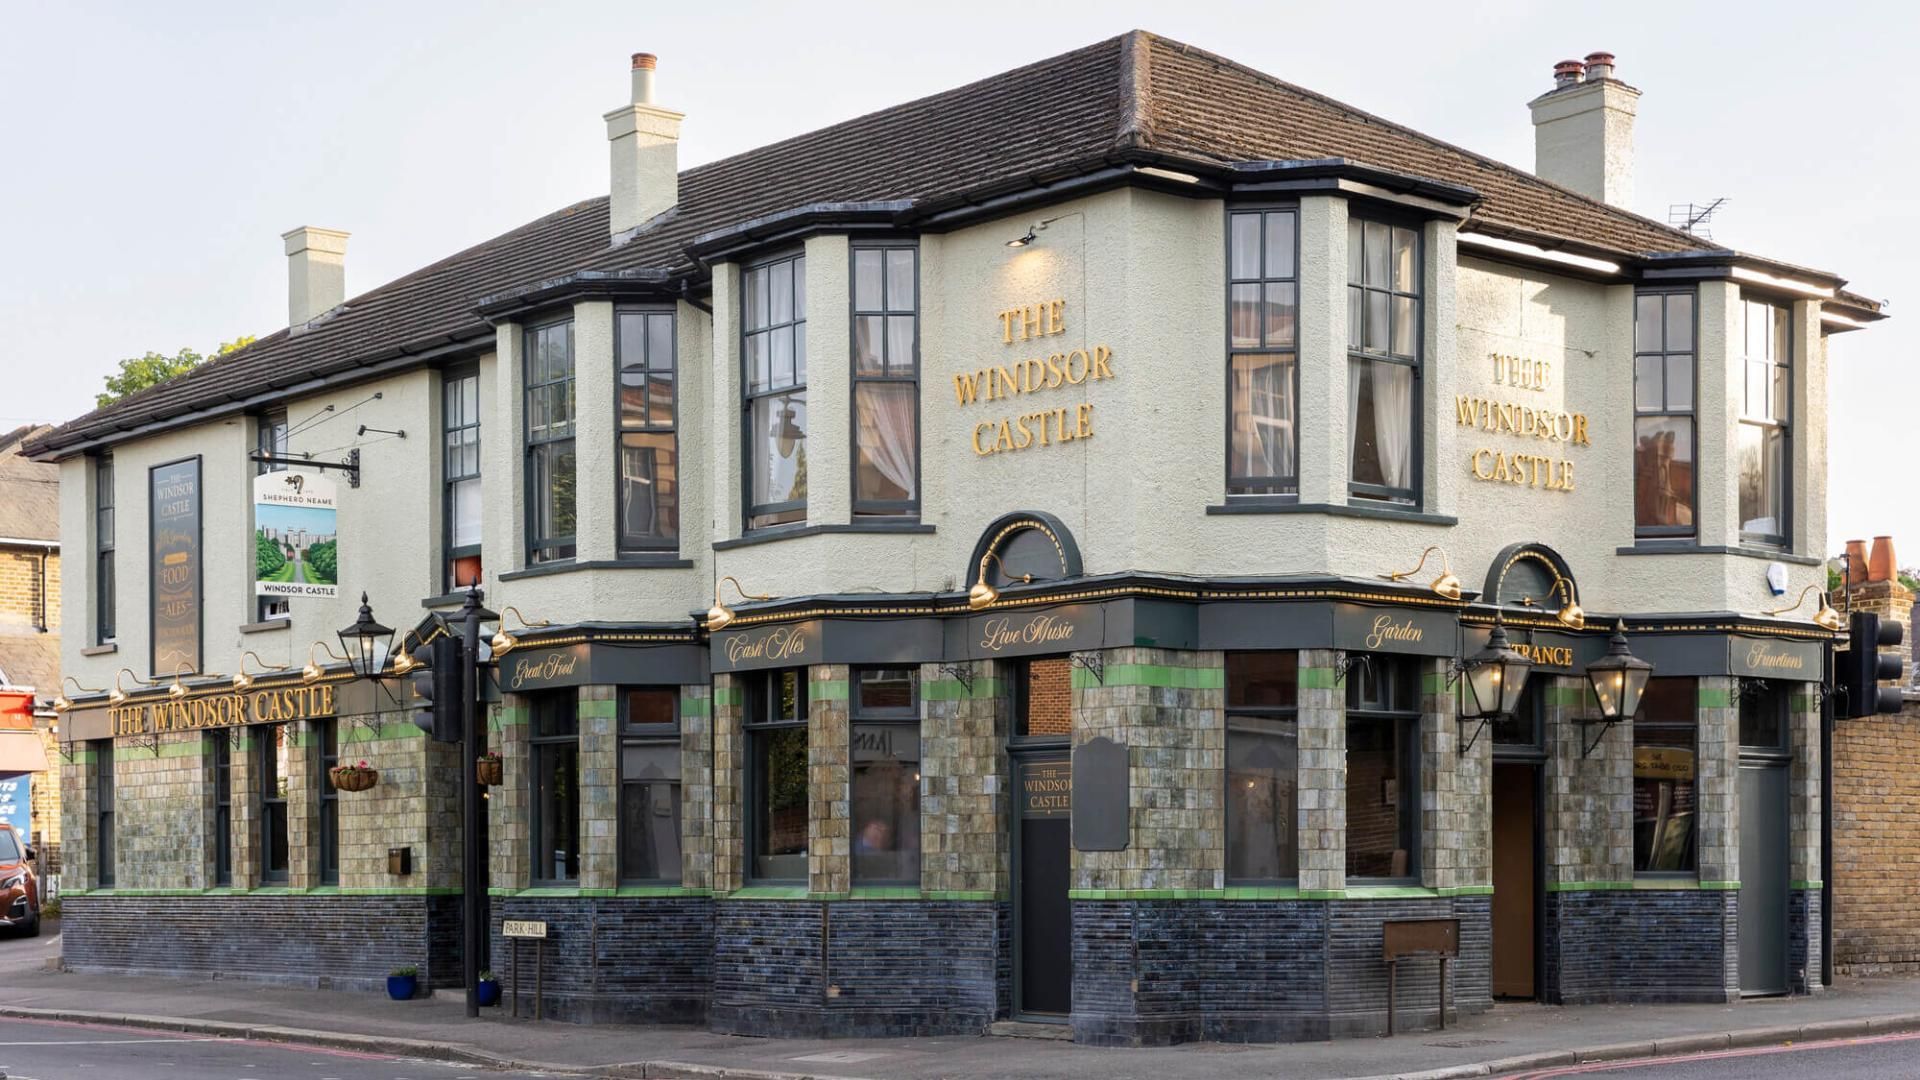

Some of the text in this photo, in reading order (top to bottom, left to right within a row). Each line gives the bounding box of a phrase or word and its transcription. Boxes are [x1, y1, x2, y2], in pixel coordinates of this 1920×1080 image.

[998, 298, 1066, 345] THE
[953, 345, 1115, 407] WINDSOR
[1488, 353, 1551, 392] THE
[972, 402, 1094, 457] CASTLE
[1455, 393, 1591, 447] WINDSOR
[1472, 447, 1575, 492] CASTLE
[157, 482, 194, 499] WINDSOR
[263, 494, 304, 503] SHEPHERD
[161, 500, 190, 516] CASTLE
[163, 566, 188, 584] FOOD
[264, 585, 335, 595] WINDSOR CASTLE
[166, 601, 186, 615] ALES
[766, 627, 805, 659] Ales
[980, 615, 1074, 650] Live Music
[1366, 615, 1423, 648] Garden
[1506, 643, 1573, 666] TRANCE
[1747, 640, 1802, 669] Functions
[511, 654, 577, 688] Great Food
[107, 685, 333, 736] THE WINDSOR CASTLE
[1041, 769, 1057, 778] THE
[1030, 795, 1069, 808] CASTLE
[506, 923, 544, 935] PARK HILL
